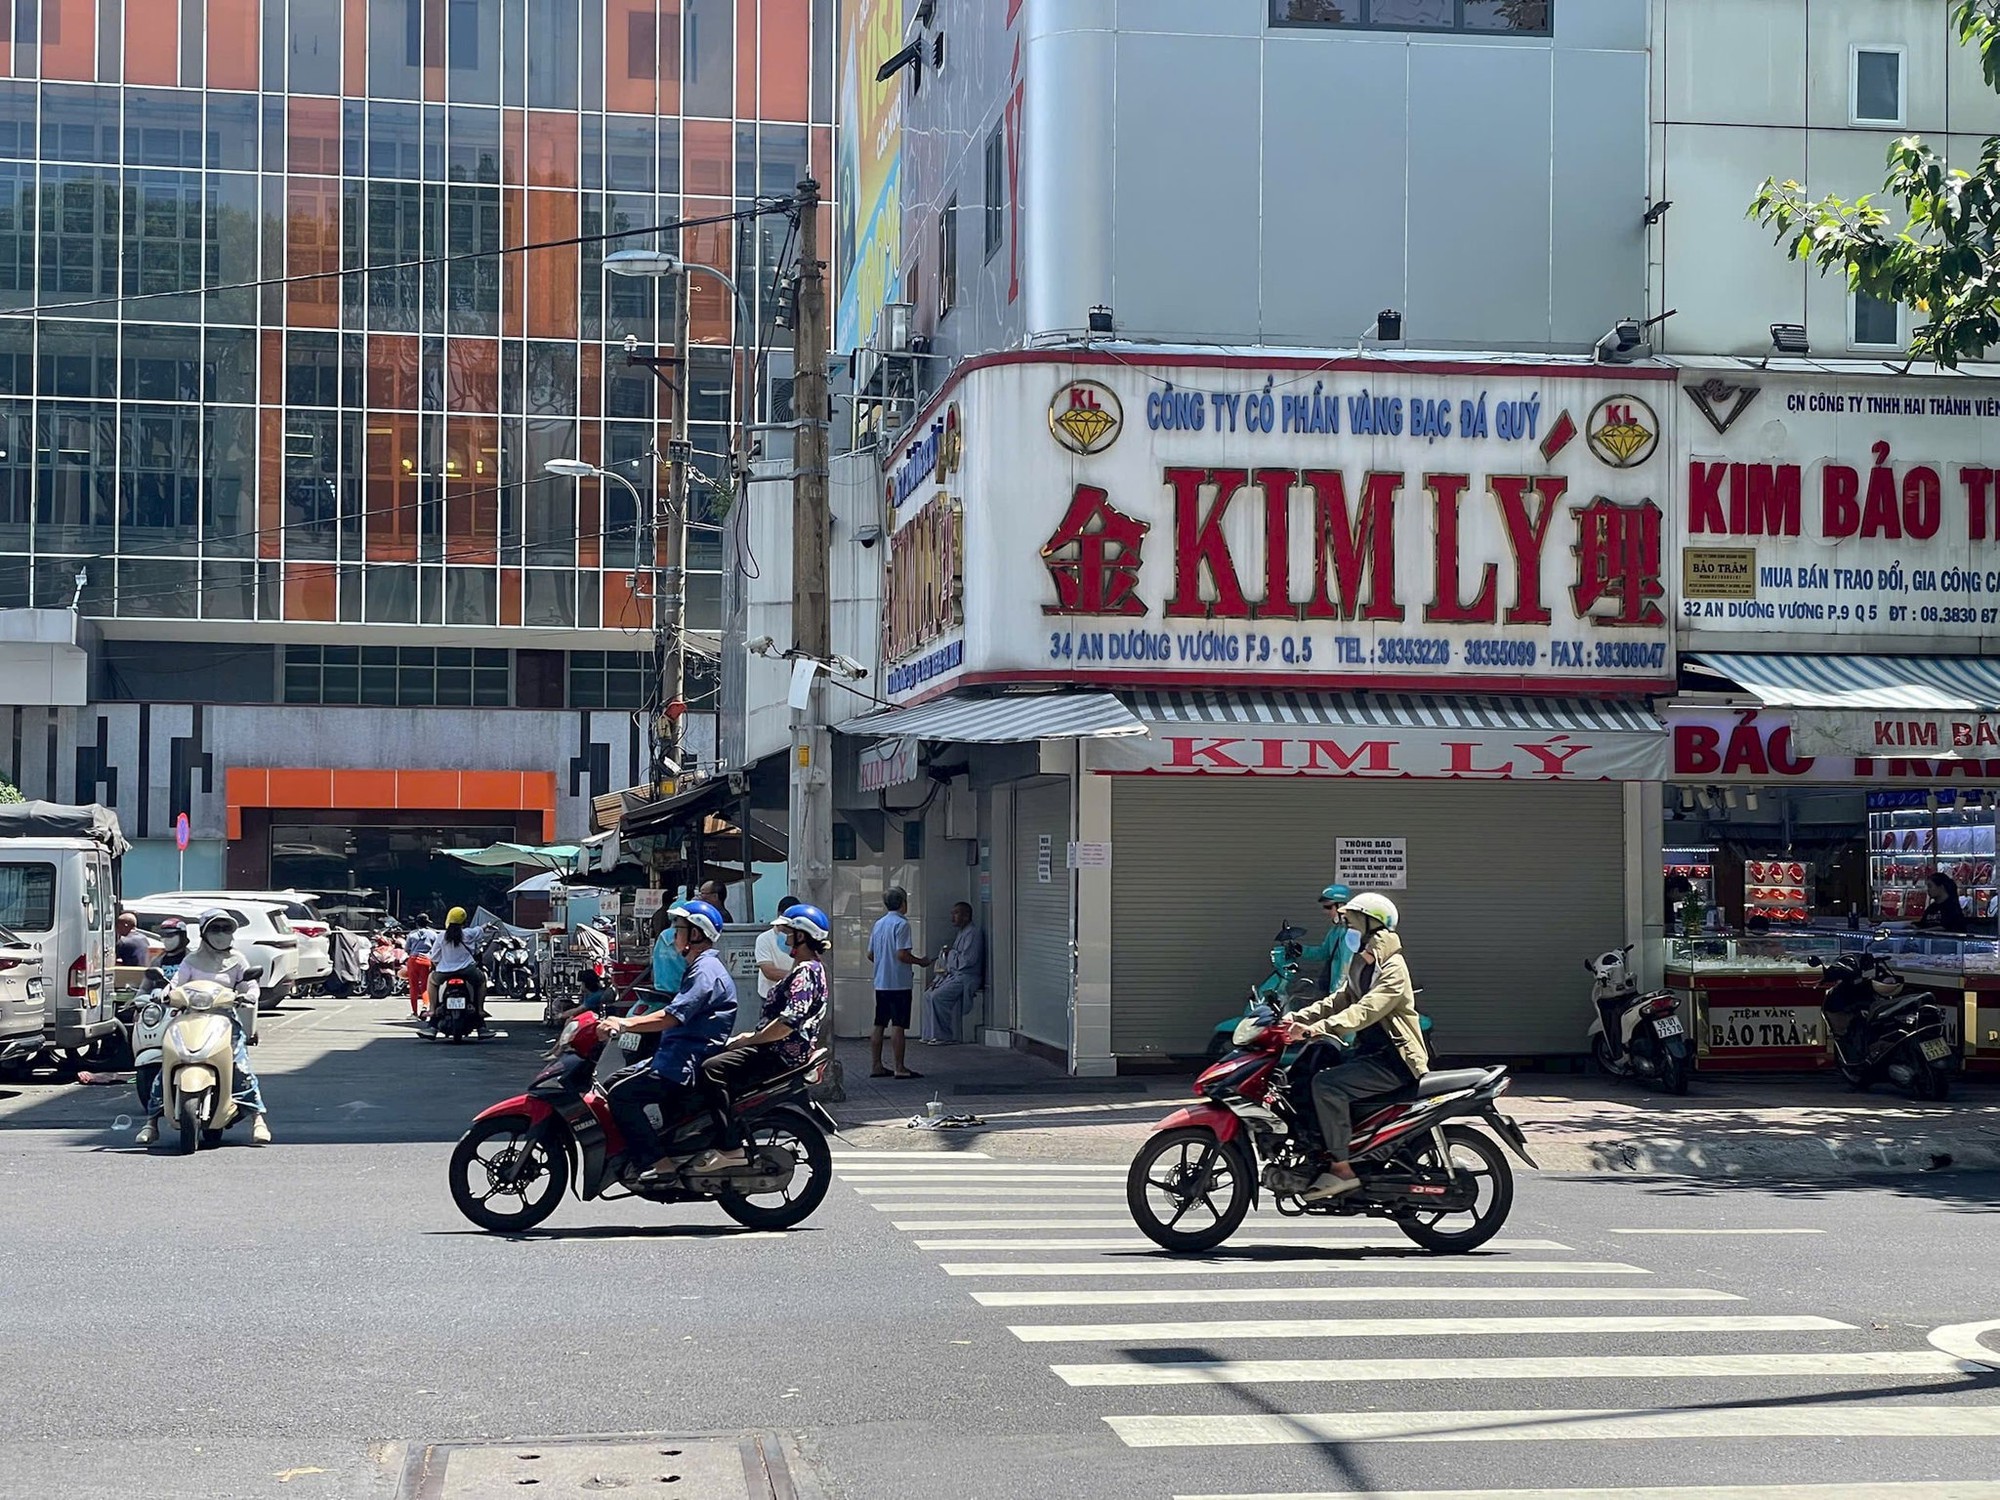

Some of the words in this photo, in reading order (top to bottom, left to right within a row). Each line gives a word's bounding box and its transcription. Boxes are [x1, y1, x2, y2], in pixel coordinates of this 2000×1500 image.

[1070, 388, 1101, 409] KL
[1147, 381, 1204, 431] CÔNG
[1211, 393, 1241, 432] TY
[1245, 374, 1275, 433] CỔ
[1281, 380, 1339, 434] PHẦN
[1348, 388, 1403, 436] VÀNG
[1410, 399, 1451, 444] BẠC
[1460, 391, 1488, 438] ĐÁ
[1496, 391, 1540, 440] QUÝ
[1787, 394, 1805, 412] CN
[1809, 391, 1844, 413] CÔNG
[1848, 396, 1863, 412] TY
[1867, 396, 1900, 413] TNHH
[1904, 397, 1925, 414] HAI
[1929, 395, 1971, 416] THÀNH
[1605, 404, 1638, 425] KL
[1688, 461, 1801, 536] KIM
[1822, 440, 1941, 540] BẢO
[1163, 467, 1405, 622] KIM
[1421, 408, 1578, 626] LÝ
[1040, 484, 1150, 617] 金
[1693, 560, 1715, 573] BẢO
[1760, 567, 1793, 588] MUA
[1798, 563, 1829, 589] BÁN
[1834, 569, 1873, 590] TRAO
[1878, 560, 1909, 595] ĐỔI,
[1912, 570, 1937, 592] GIA
[1941, 566, 1981, 593] CÔNG
[1683, 602, 1700, 617] 32
[1704, 602, 1724, 618] AN
[1728, 601, 1774, 619] DƯƠNG
[1779, 602, 1823, 620] VƯƠNG
[1828, 604, 1849, 620] P.9
[1855, 605, 1864, 622] Q
[1868, 605, 1878, 620] 5
[1889, 606, 1907, 622] ĐT
[1920, 606, 1976, 623] 08.3830
[1050, 632, 1073, 660] 34
[1077, 633, 1103, 660] AN
[1108, 629, 1171, 662] DƯƠNG
[1177, 630, 1239, 662] VƯƠNG
[1246, 634, 1270, 662] F.9
[1281, 636, 1313, 664] Q.5
[1378, 638, 1450, 666] 38353226
[1464, 639, 1536, 667] 38355099
[1594, 642, 1666, 669] 38308047
[1873, 721, 1938, 746] KIM
[1952, 714, 2000, 747] BẢ
[1161, 736, 1400, 771] KIM
[1440, 734, 1593, 775] LÝ
[862, 759, 884, 788] KIM
[1733, 1008, 1760, 1020] TIỆM
[1711, 1015, 1754, 1046] BẢO
[572, 1118, 598, 1132] YAMAHA
